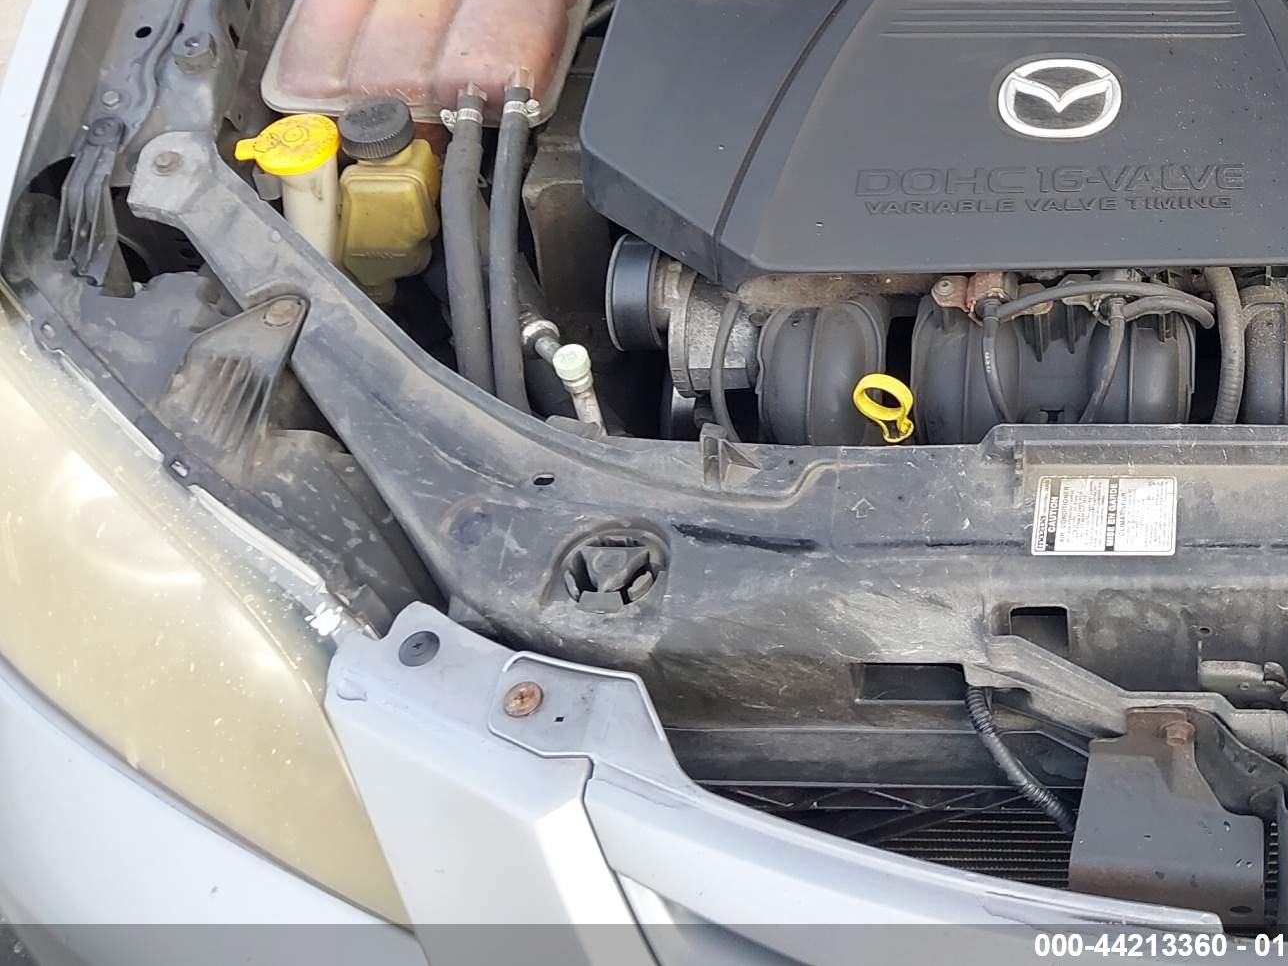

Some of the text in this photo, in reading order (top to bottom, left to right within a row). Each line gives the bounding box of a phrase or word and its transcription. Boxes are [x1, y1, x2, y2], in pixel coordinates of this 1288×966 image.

[855, 163, 1246, 197] DOHC 16-VALVE
[864, 195, 1232, 215] VARIABLE VALVE TIMING
[1047, 496, 1060, 533] CAUTION
[1107, 512, 1116, 525] EN
